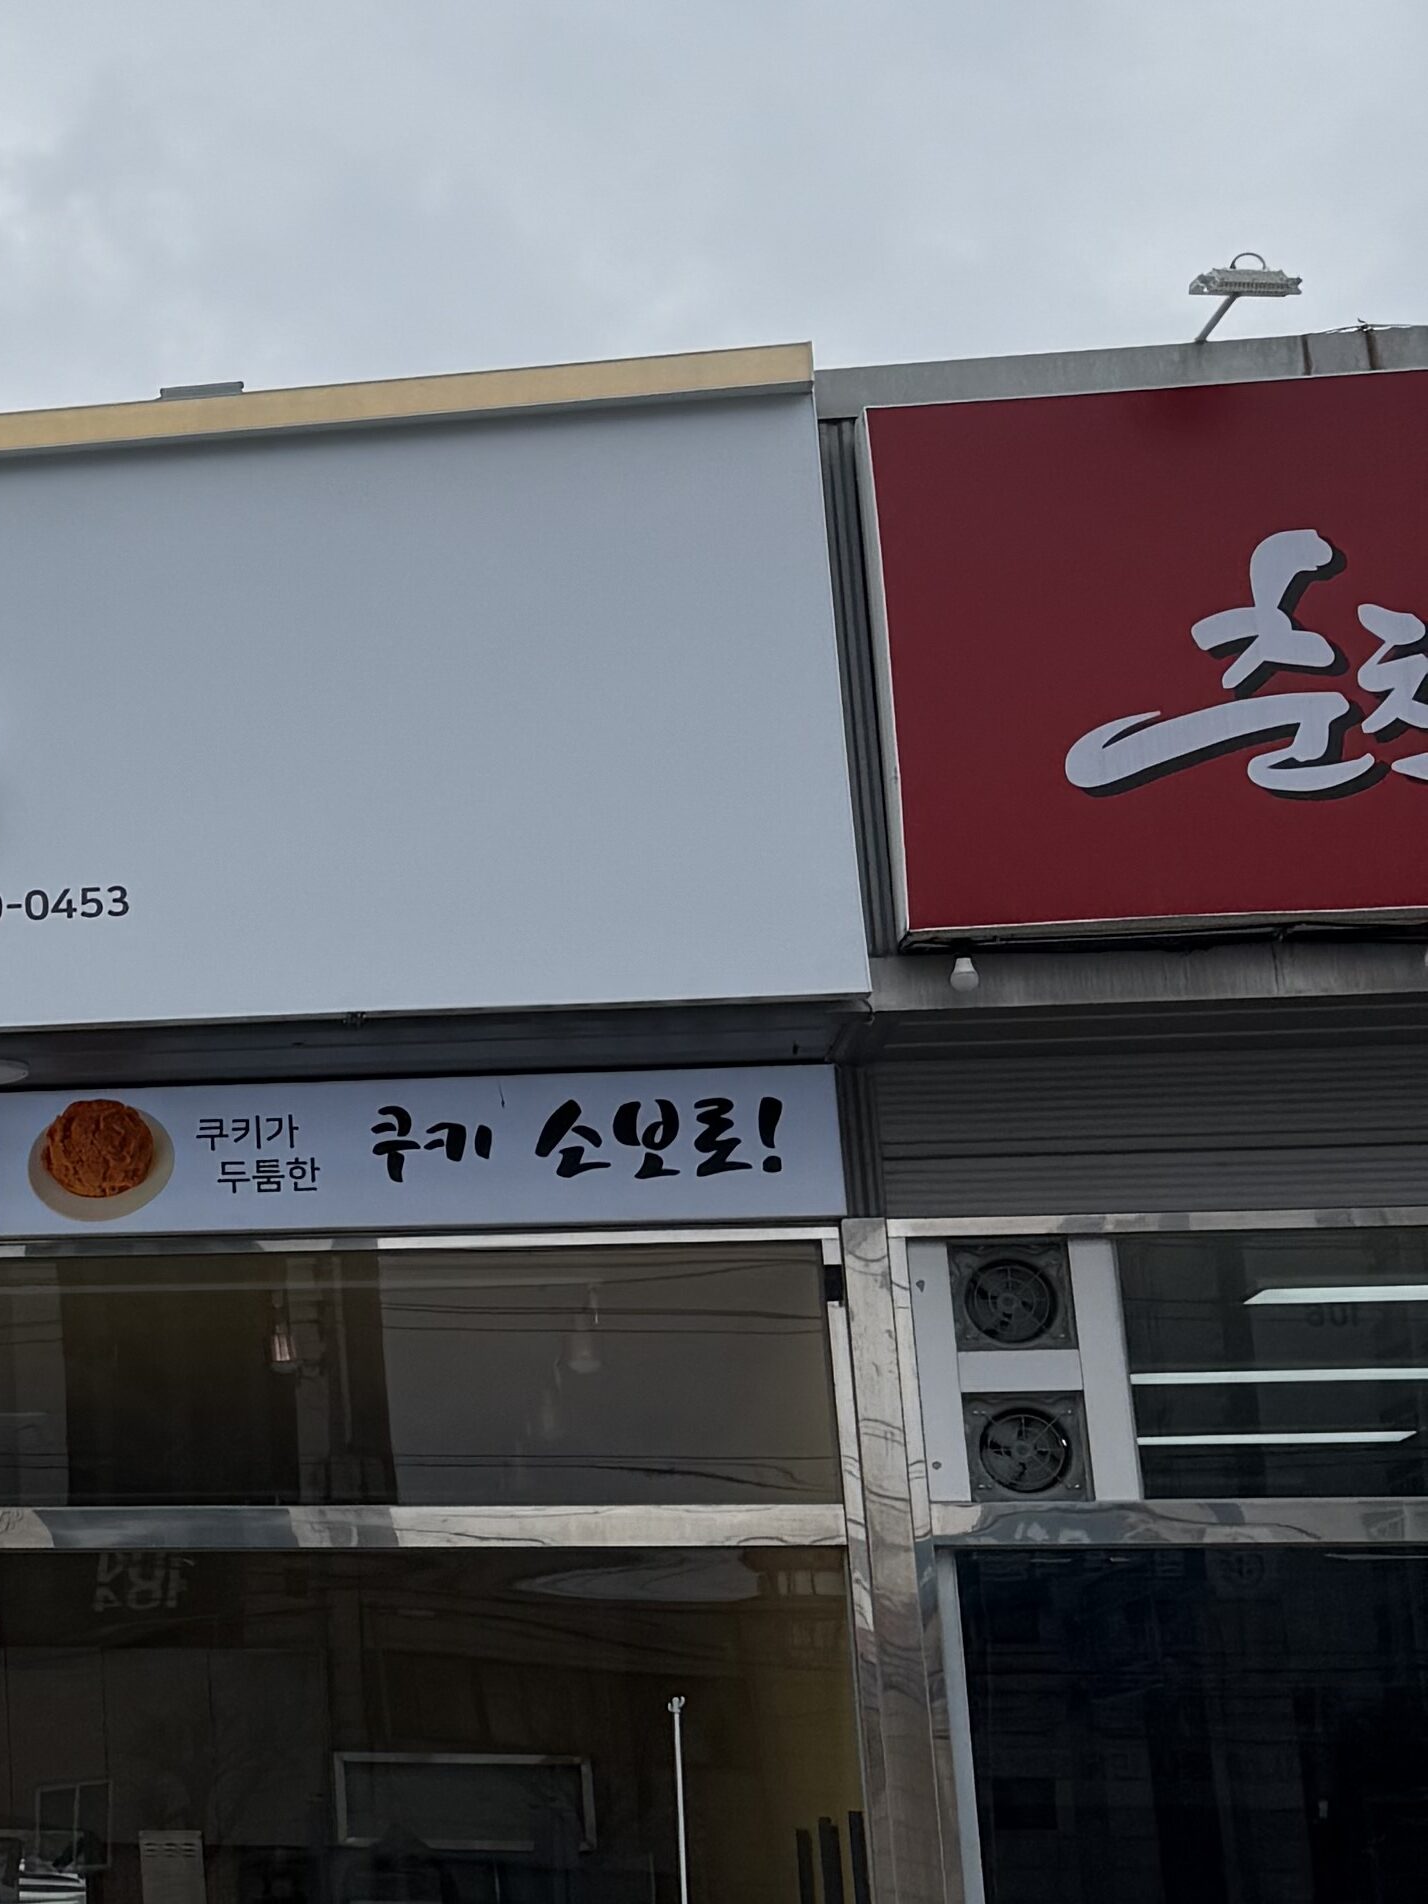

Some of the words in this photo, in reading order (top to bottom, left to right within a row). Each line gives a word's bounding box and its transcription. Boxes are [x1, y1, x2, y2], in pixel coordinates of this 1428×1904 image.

[196, 1114, 299, 1151] 쿠키가
[371, 1106, 492, 1182] 쿠키
[535, 1097, 782, 1179] 소보로!
[217, 1157, 320, 1193] 두툼한
